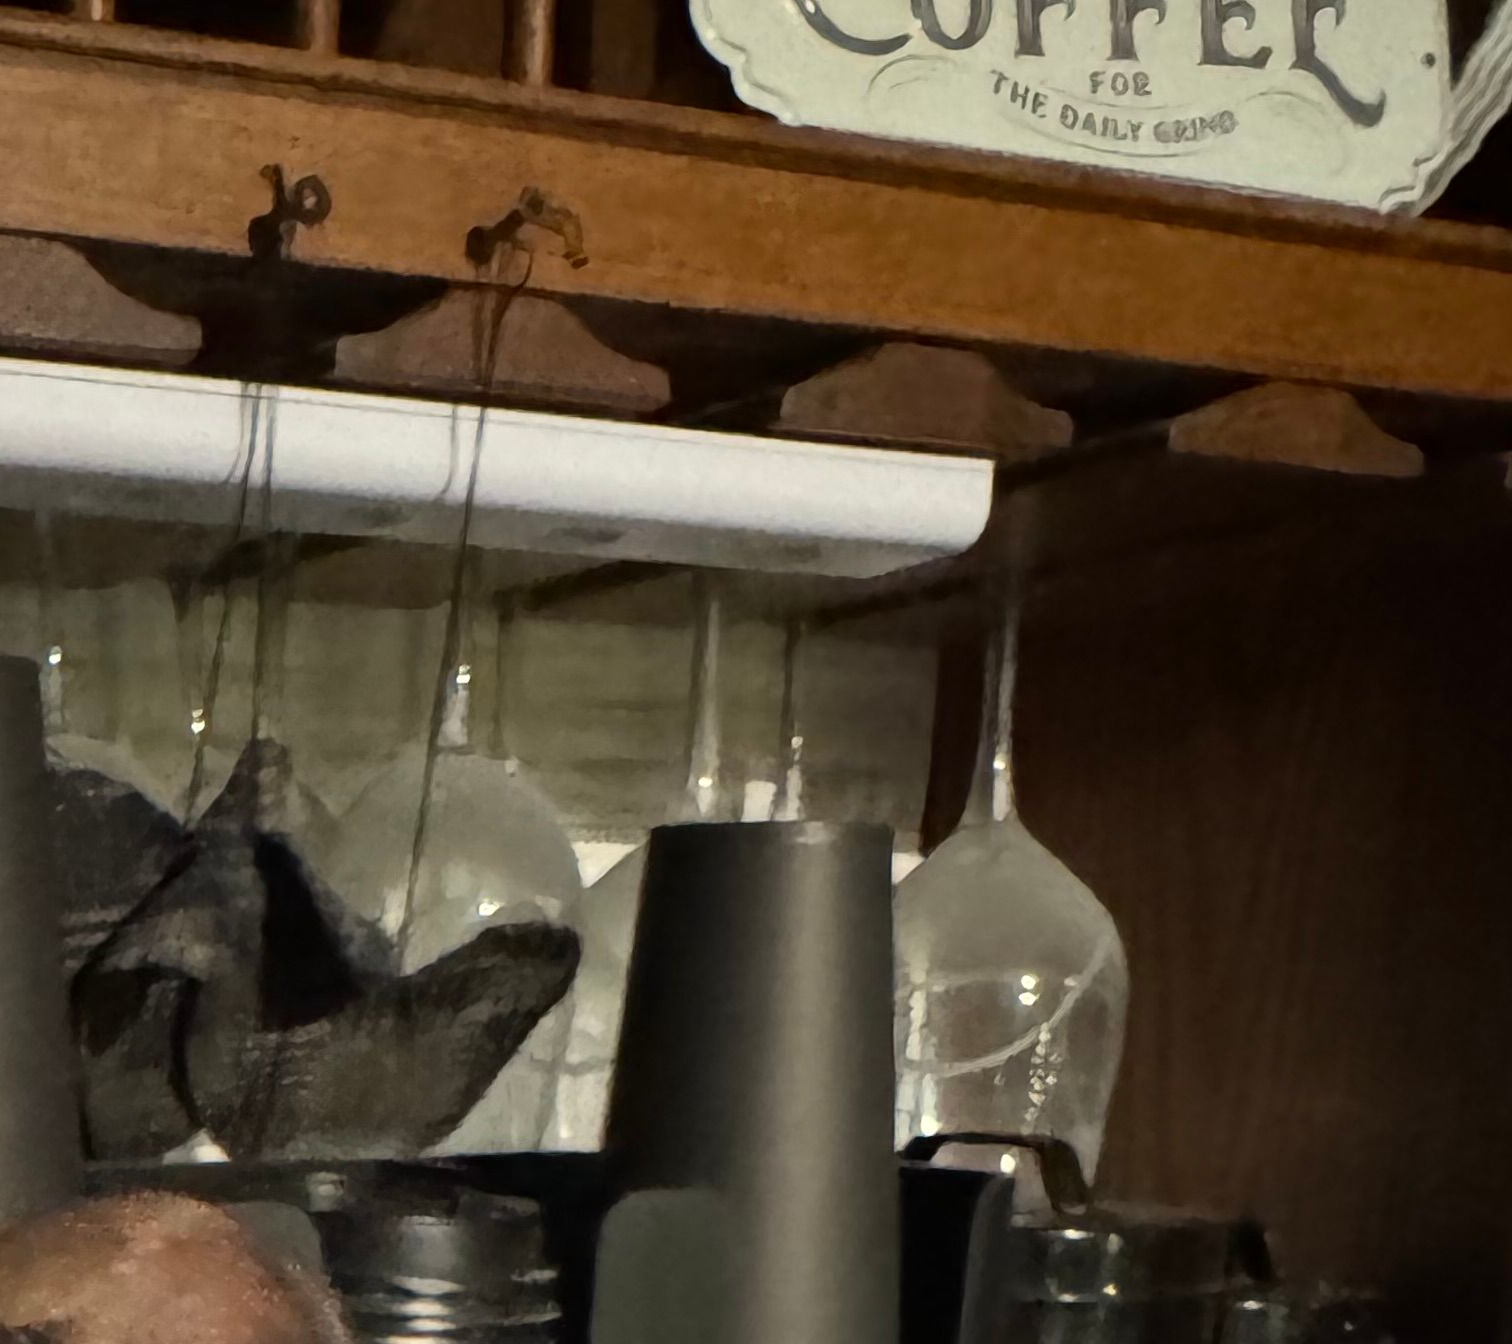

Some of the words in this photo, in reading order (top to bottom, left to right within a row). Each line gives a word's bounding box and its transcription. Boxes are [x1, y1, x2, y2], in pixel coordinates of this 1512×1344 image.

[990, 69, 1049, 118] THE
[1059, 103, 1144, 141] DAILY
[1089, 70, 1152, 96] FOR
